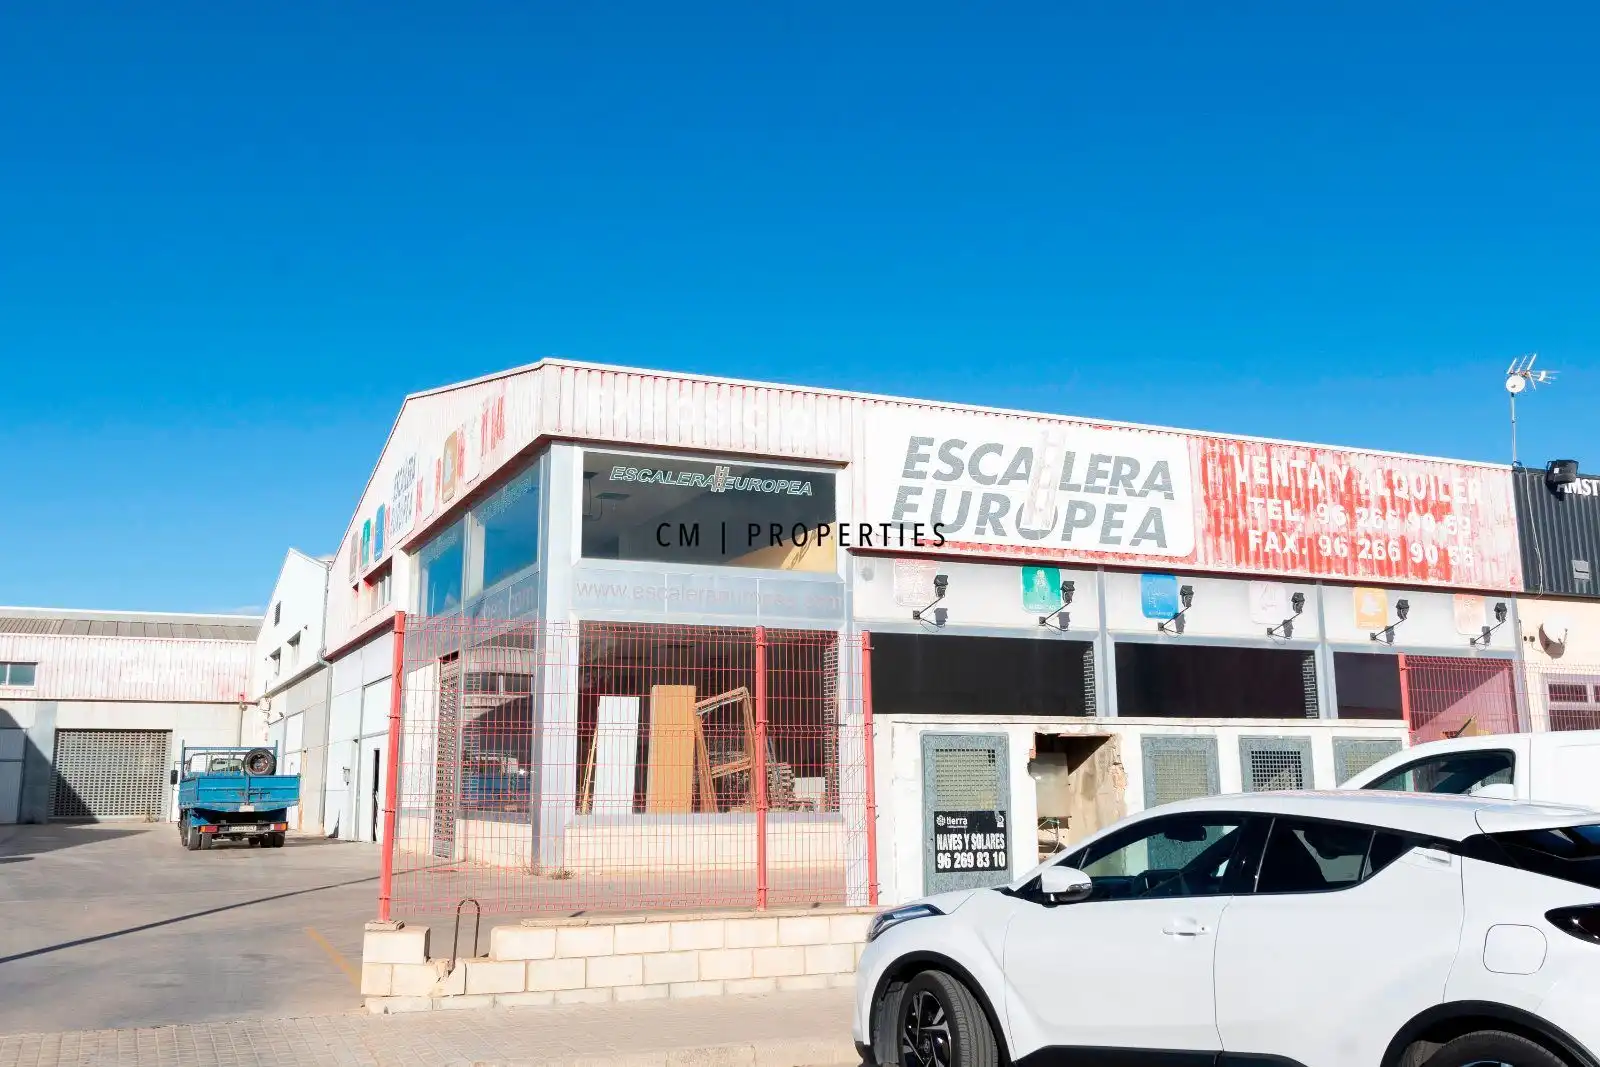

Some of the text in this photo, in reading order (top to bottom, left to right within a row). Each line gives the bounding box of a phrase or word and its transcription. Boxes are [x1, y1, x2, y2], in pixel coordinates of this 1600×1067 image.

[609, 466, 813, 496] ESCALERA EUROPEA
[901, 435, 1175, 501] ESCALERA
[1233, 450, 1327, 493] VENTA
[1332, 464, 1349, 493] Y
[890, 485, 1168, 549] EUROPEA
[1316, 503, 1347, 526] 96
[1318, 535, 1348, 557] 96
[1358, 538, 1400, 562] 266
[1410, 542, 1438, 566] 90
[946, 816, 968, 825] tierra
[936, 832, 1005, 851] NAVES Y SOLARES
[937, 851, 1006, 869] 96 269 83 10
